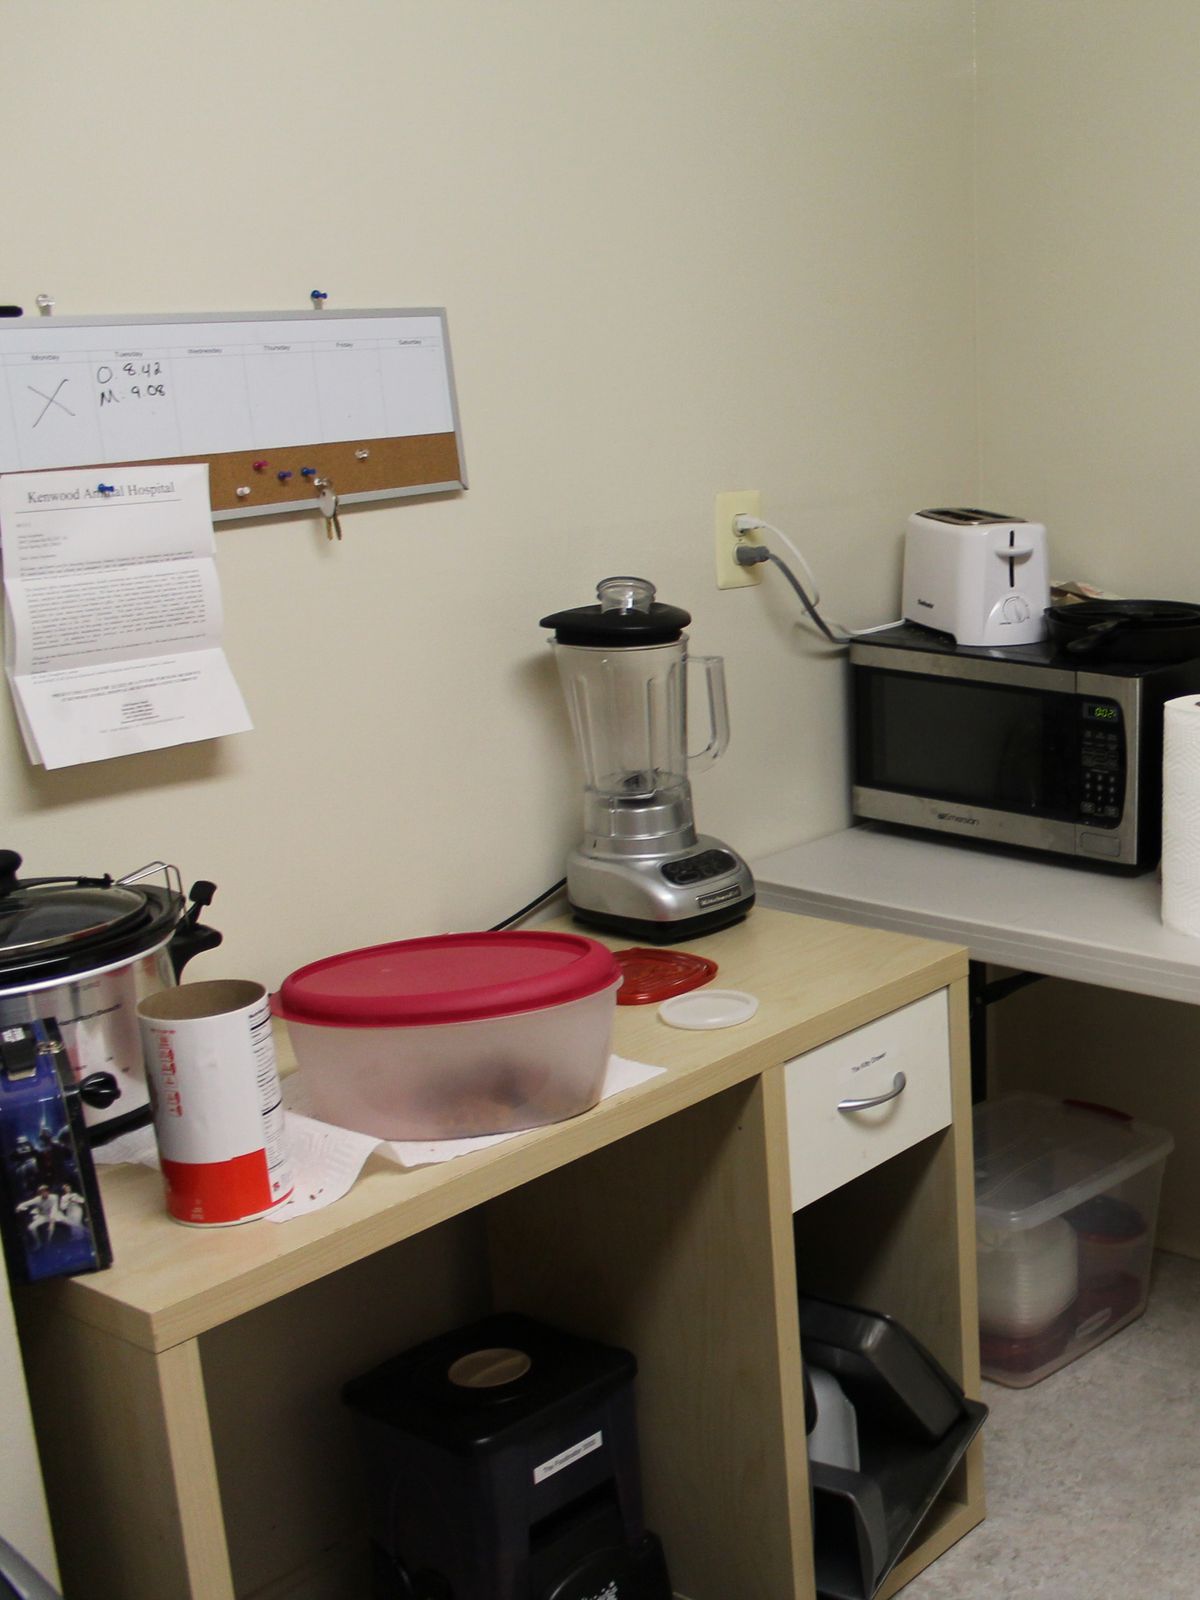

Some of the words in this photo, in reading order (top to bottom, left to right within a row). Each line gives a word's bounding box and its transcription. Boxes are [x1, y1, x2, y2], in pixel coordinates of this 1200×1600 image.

[28, 488, 80, 504] Kenwood
[83, 485, 124, 499] Anal
[127, 481, 175, 498] Hospital
